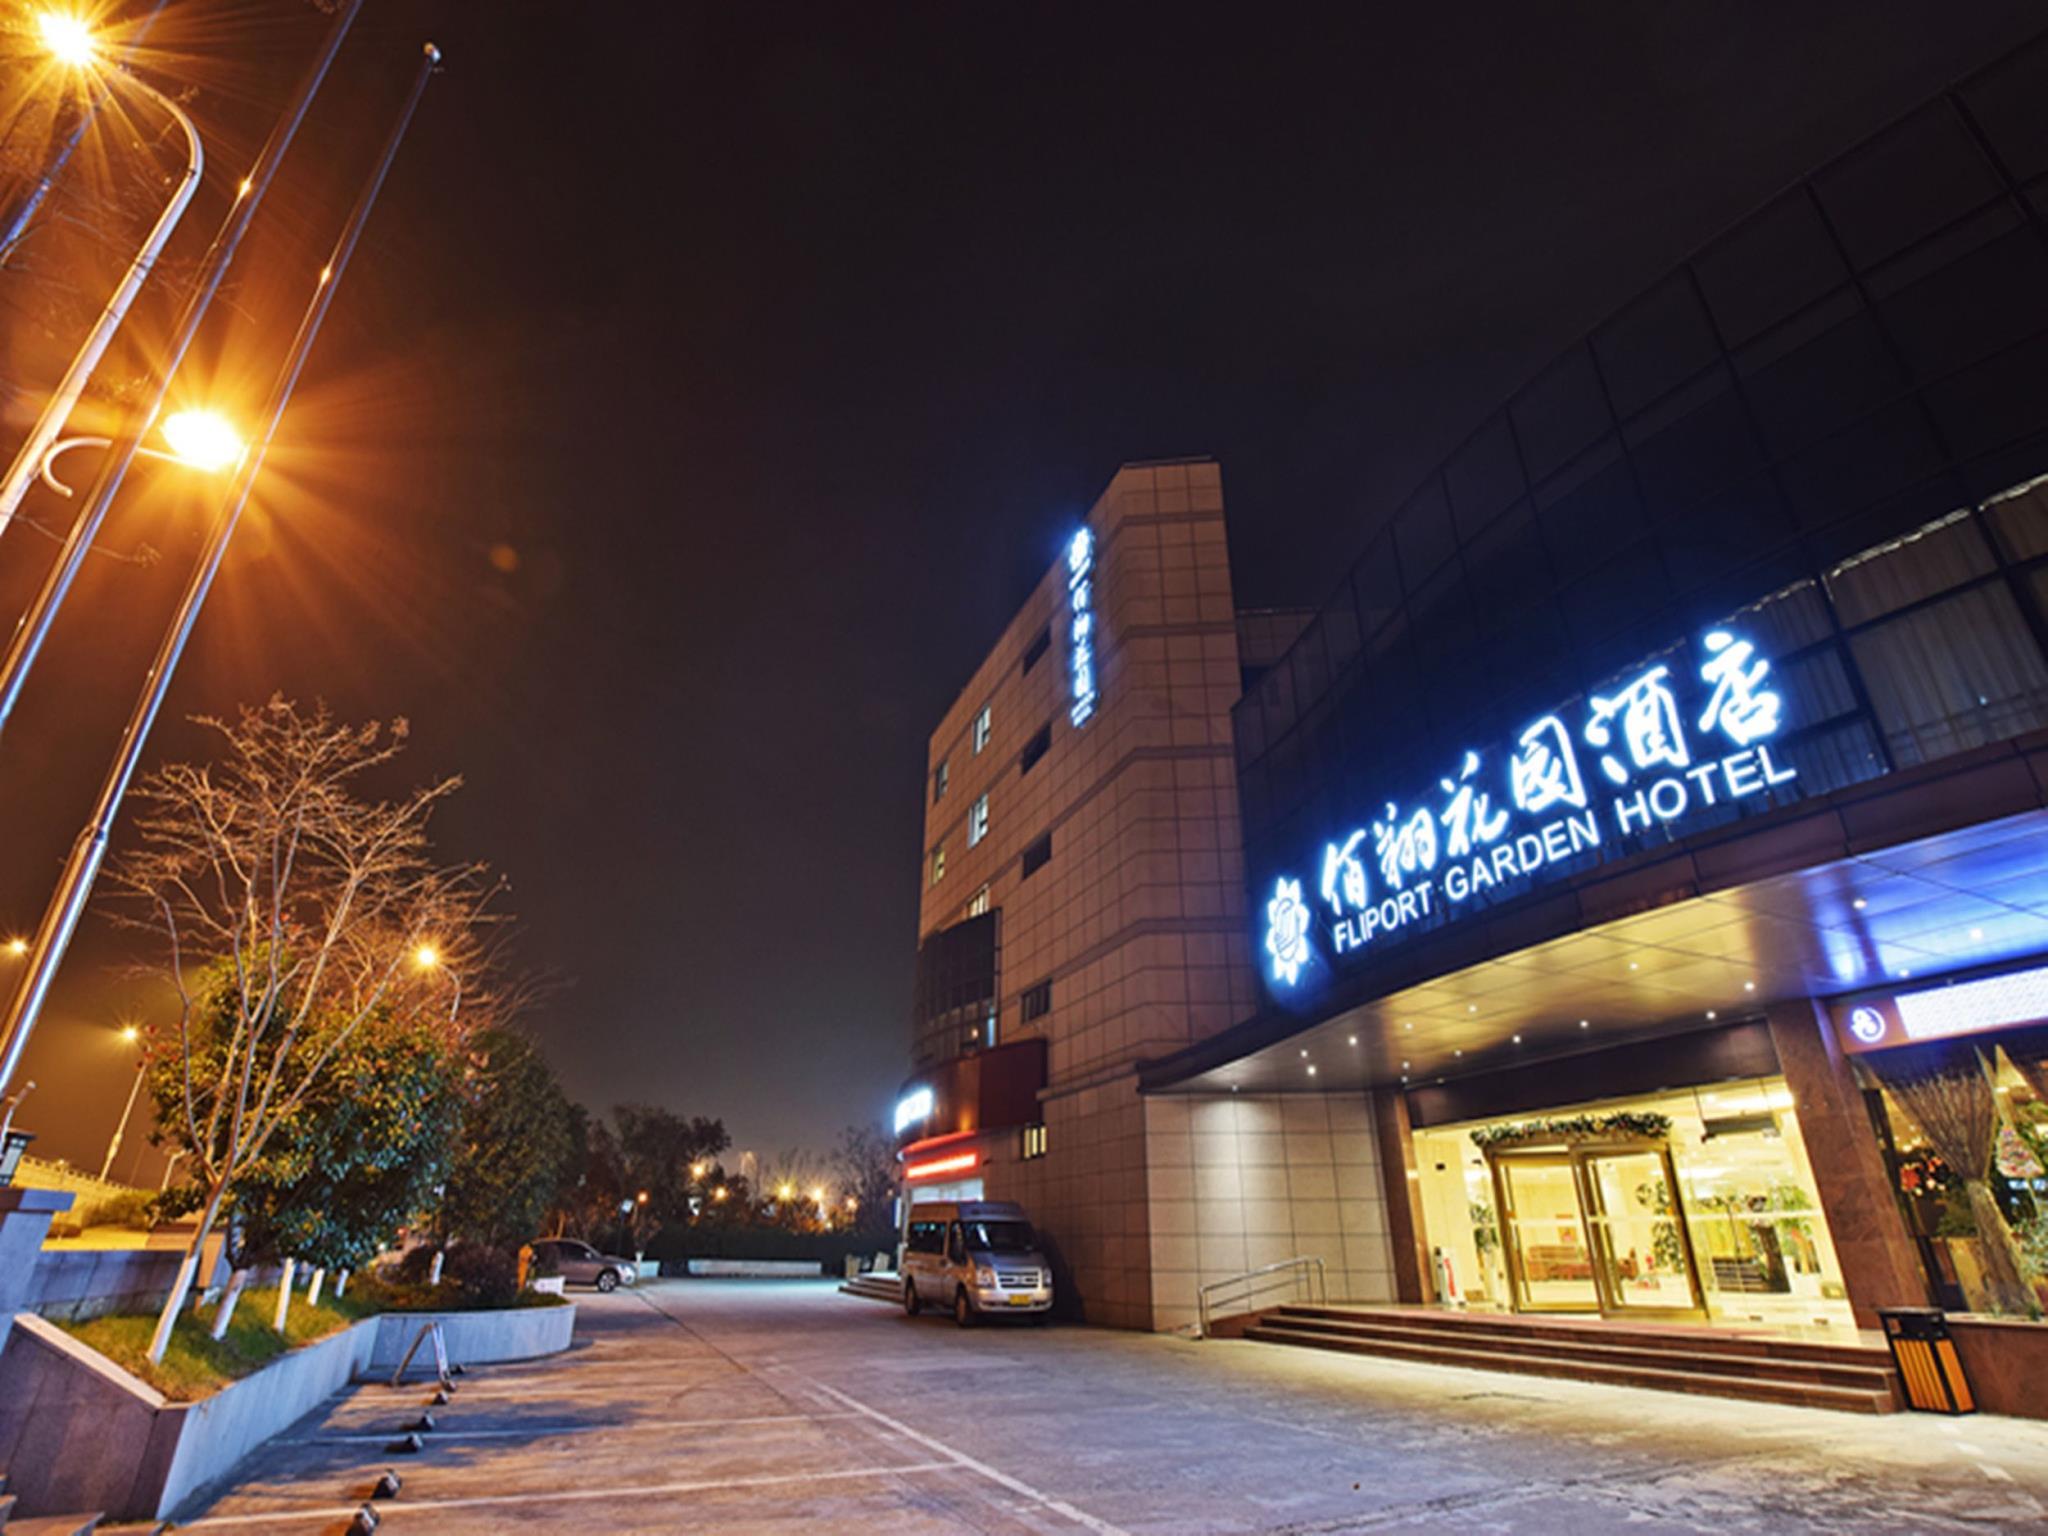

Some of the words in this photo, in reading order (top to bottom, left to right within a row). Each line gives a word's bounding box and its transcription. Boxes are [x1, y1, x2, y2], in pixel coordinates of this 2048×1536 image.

[1321, 631, 1782, 916] 佰翔花园酒店
[1334, 881, 1433, 953] FLIPORT
[1445, 810, 1600, 901] GARDEN
[1615, 745, 1796, 834] HOTEL
